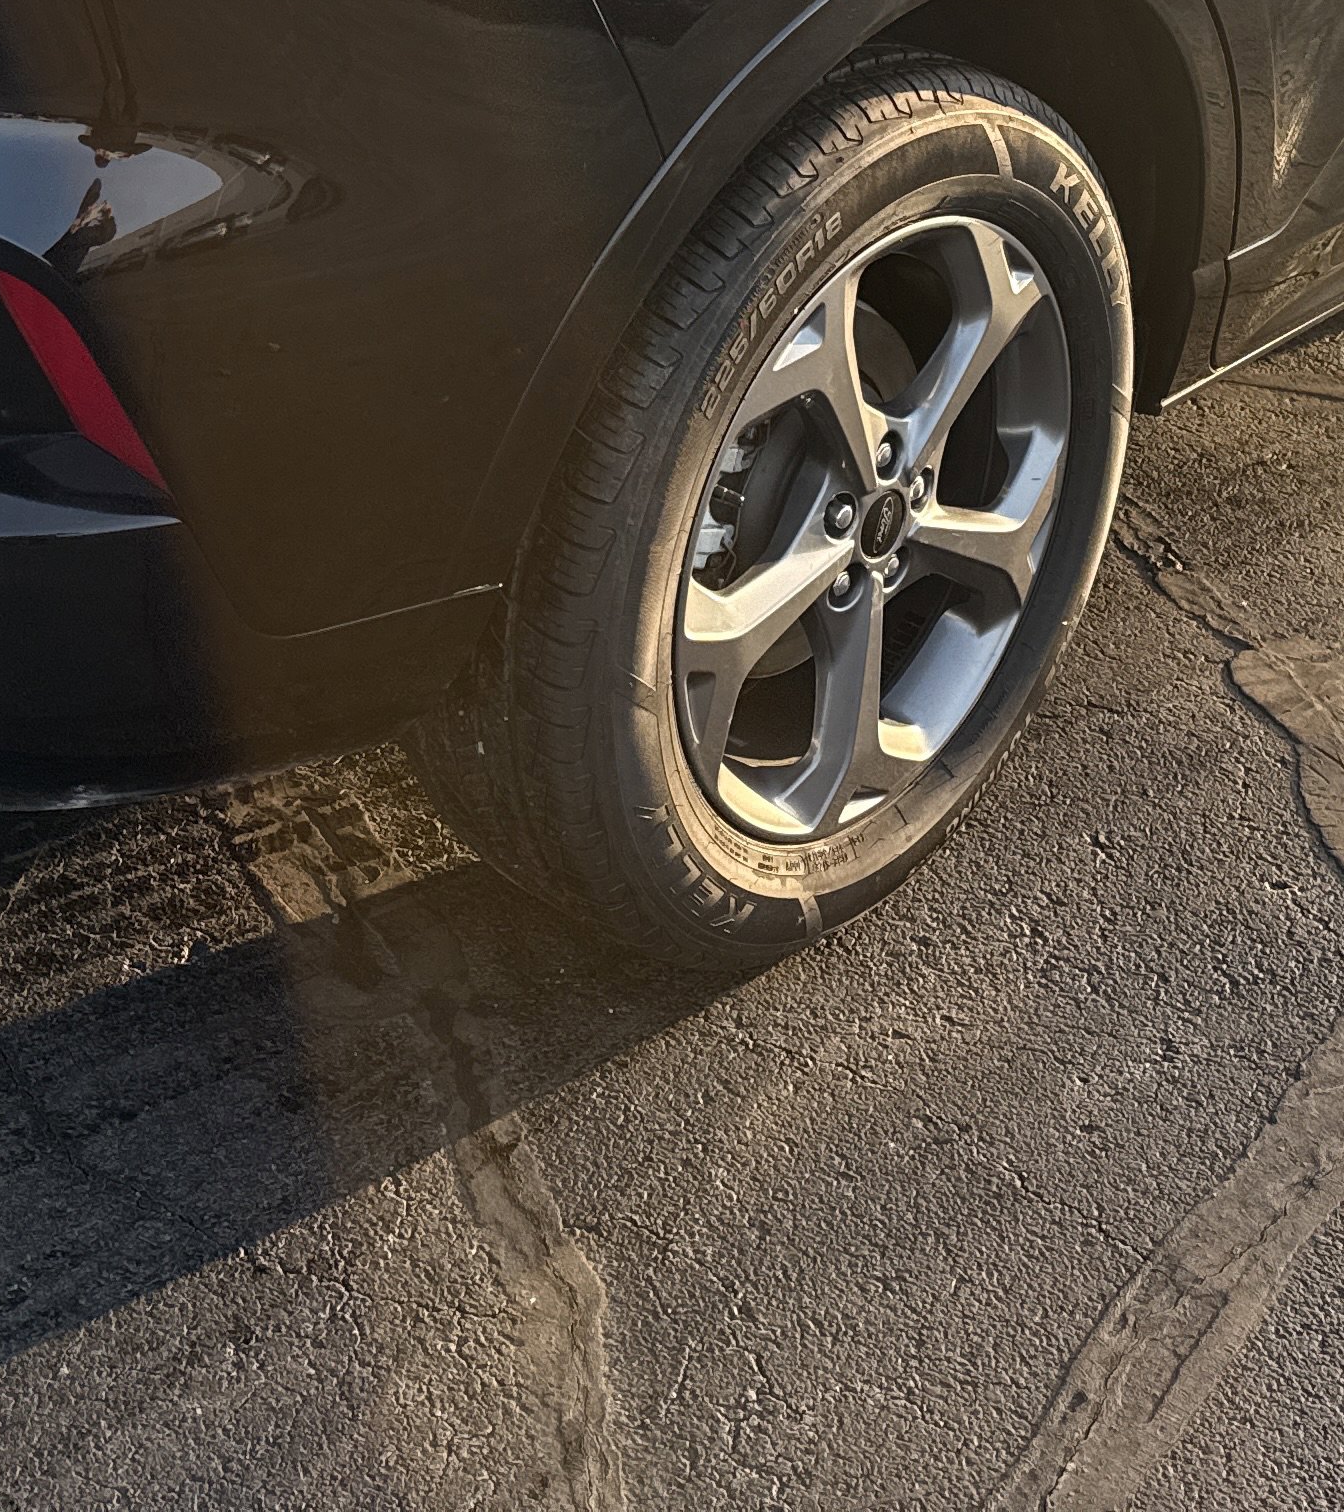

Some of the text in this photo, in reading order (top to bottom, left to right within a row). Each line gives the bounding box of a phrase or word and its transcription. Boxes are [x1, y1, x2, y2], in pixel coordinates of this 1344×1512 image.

[1049, 161, 1129, 307] KELLY
[701, 211, 843, 420] 225/60R18
[635, 803, 758, 935] KELLY
